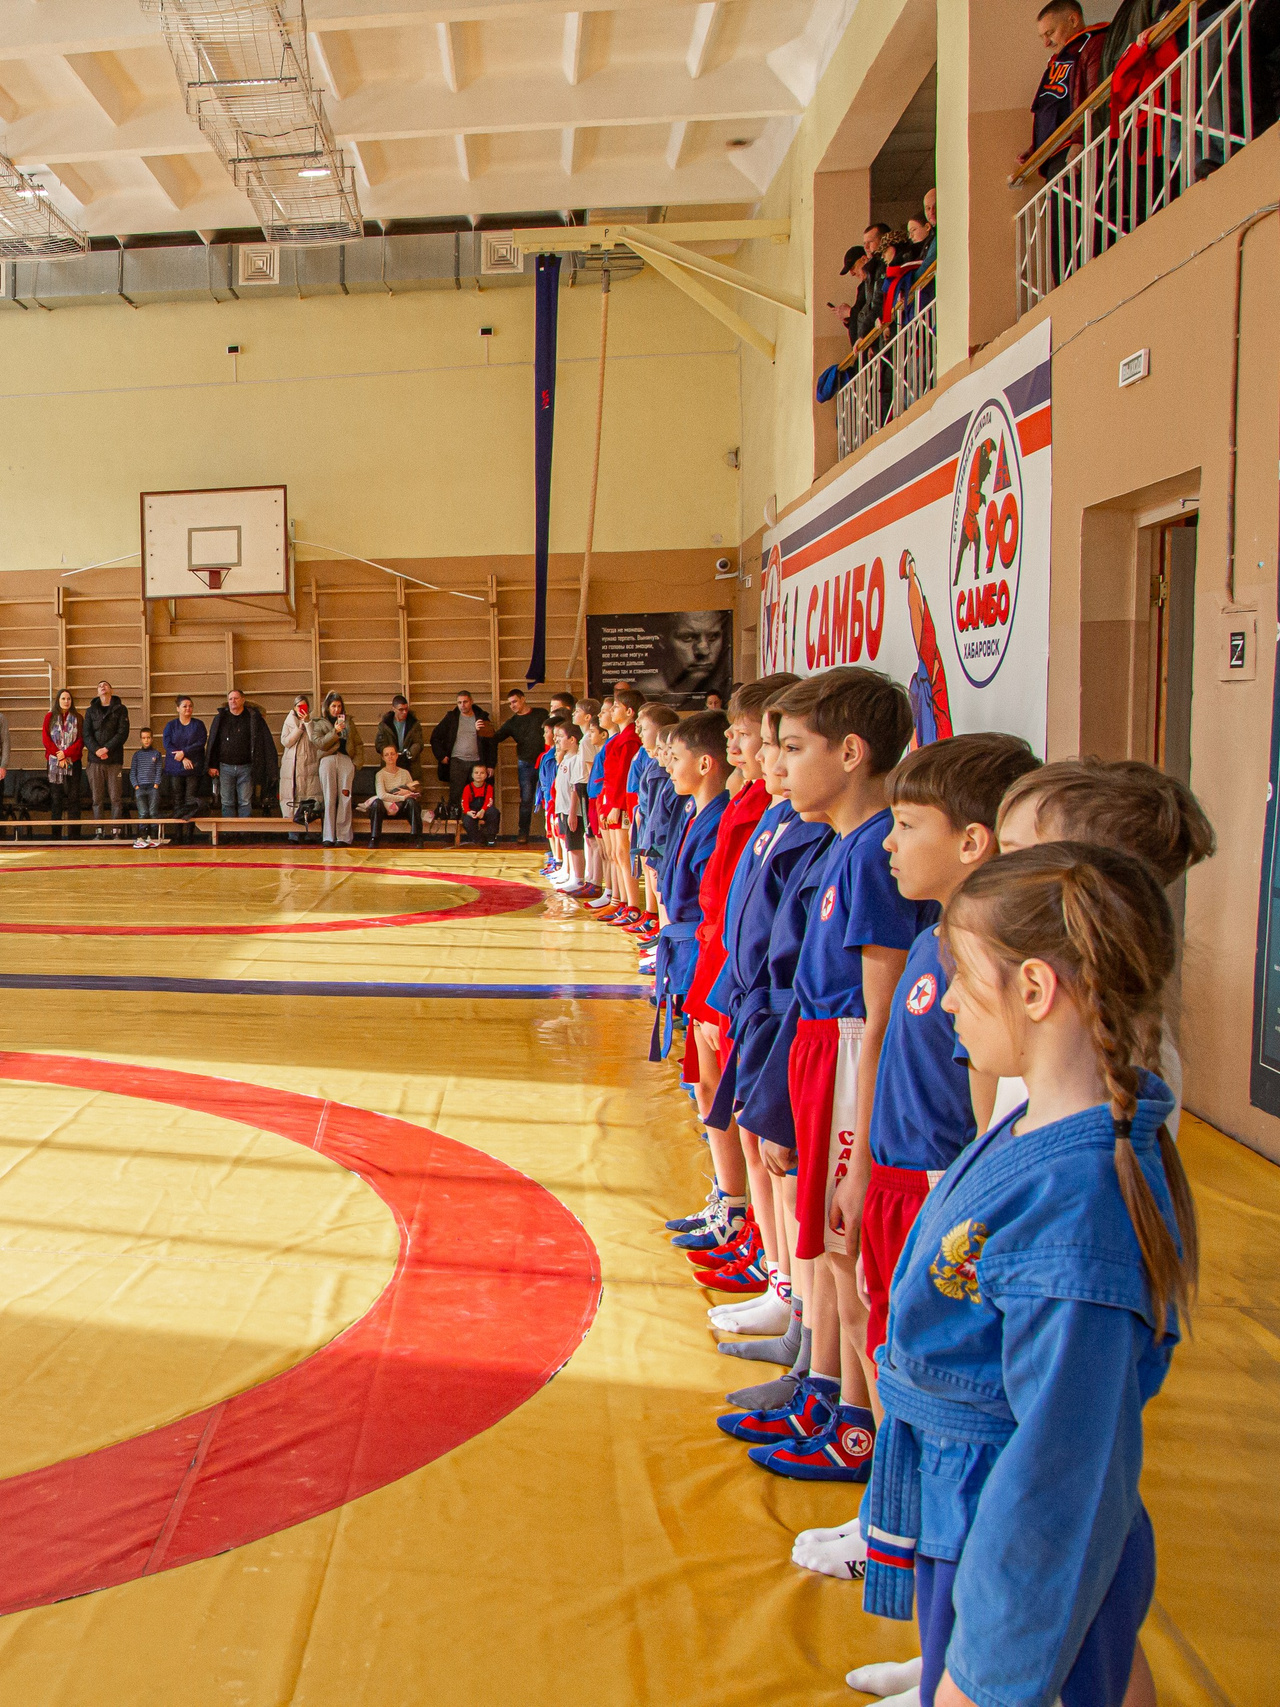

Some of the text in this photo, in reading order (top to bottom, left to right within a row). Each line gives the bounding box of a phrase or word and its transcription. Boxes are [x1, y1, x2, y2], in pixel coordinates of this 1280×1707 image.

[985, 492, 1019, 574] 90
[805, 556, 885, 671] САМБО
[956, 579, 1011, 634] САМБО
[963, 638, 1000, 660] ХАБАРОВСК
[1230, 640, 1244, 665] Z
